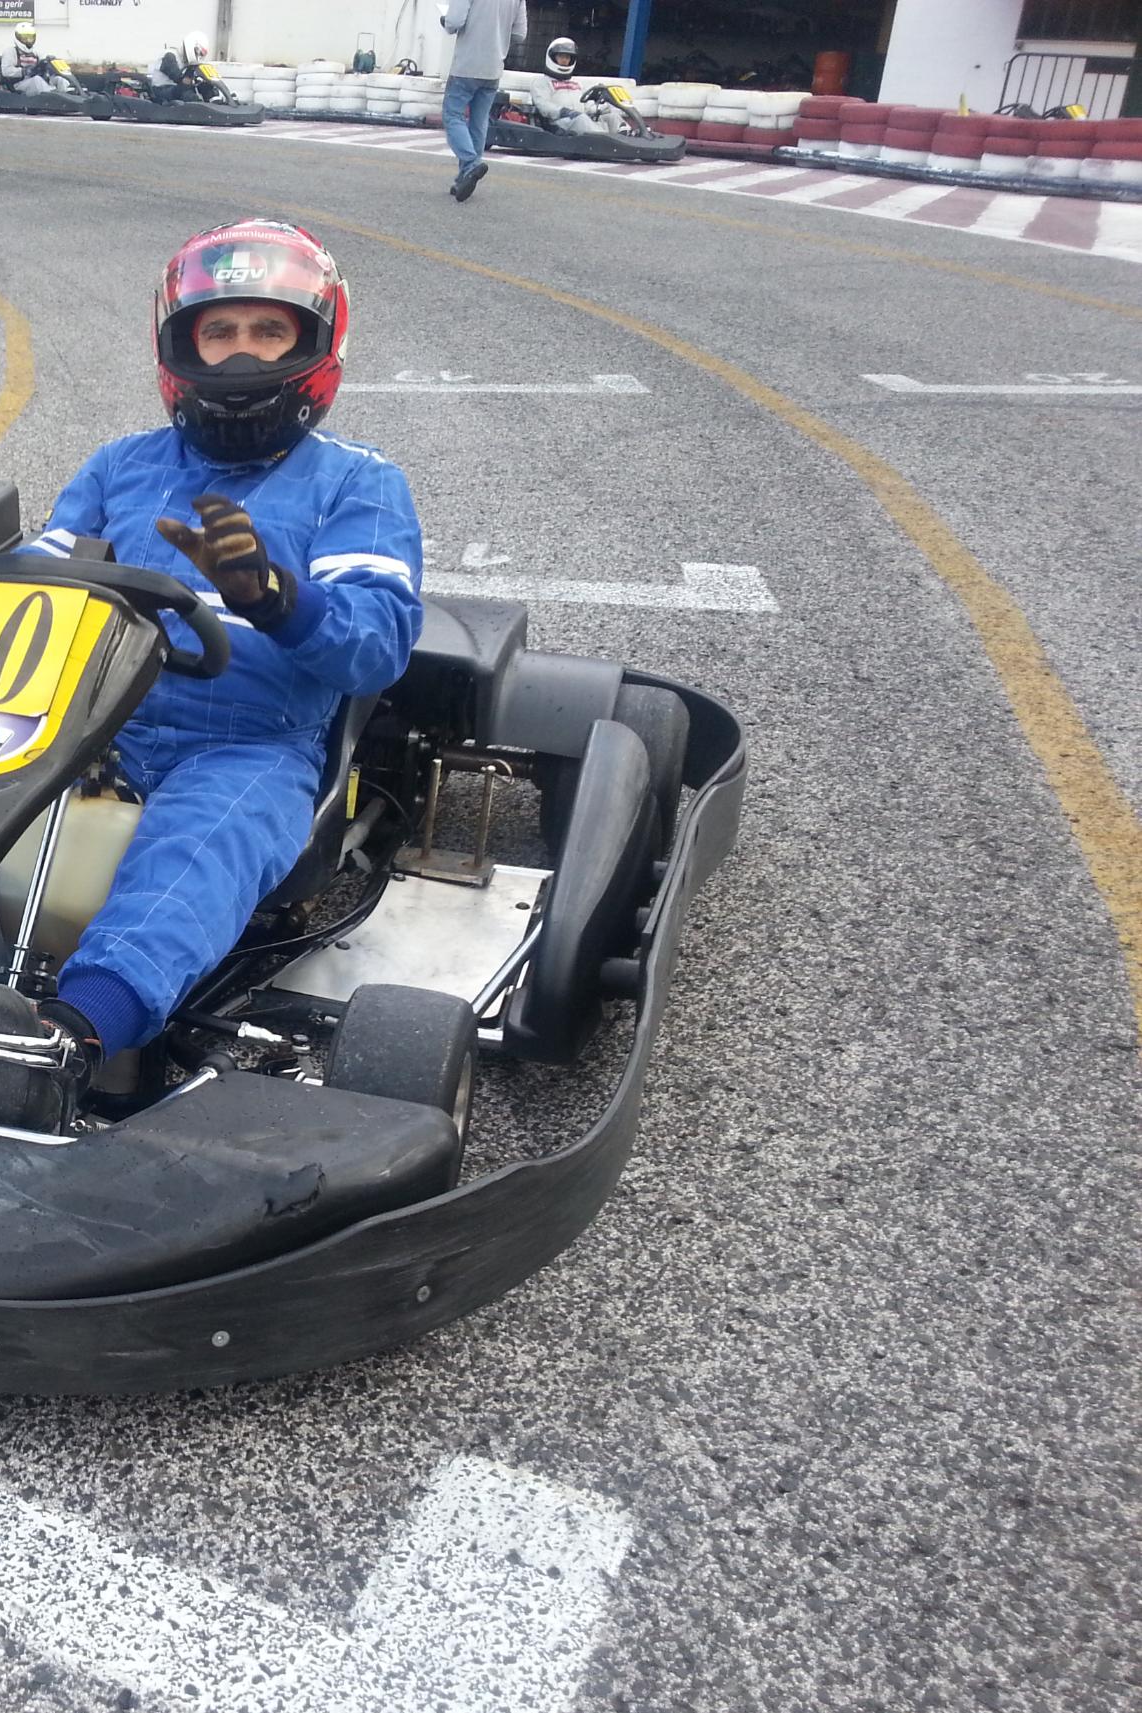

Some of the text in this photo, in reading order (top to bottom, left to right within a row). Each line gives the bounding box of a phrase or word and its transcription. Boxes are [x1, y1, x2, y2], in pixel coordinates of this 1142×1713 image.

[5, 0, 24, 8] gerir
[0, 10, 32, 18] empresa
[210, 230, 278, 243] Millennium
[215, 267, 265, 283] agv
